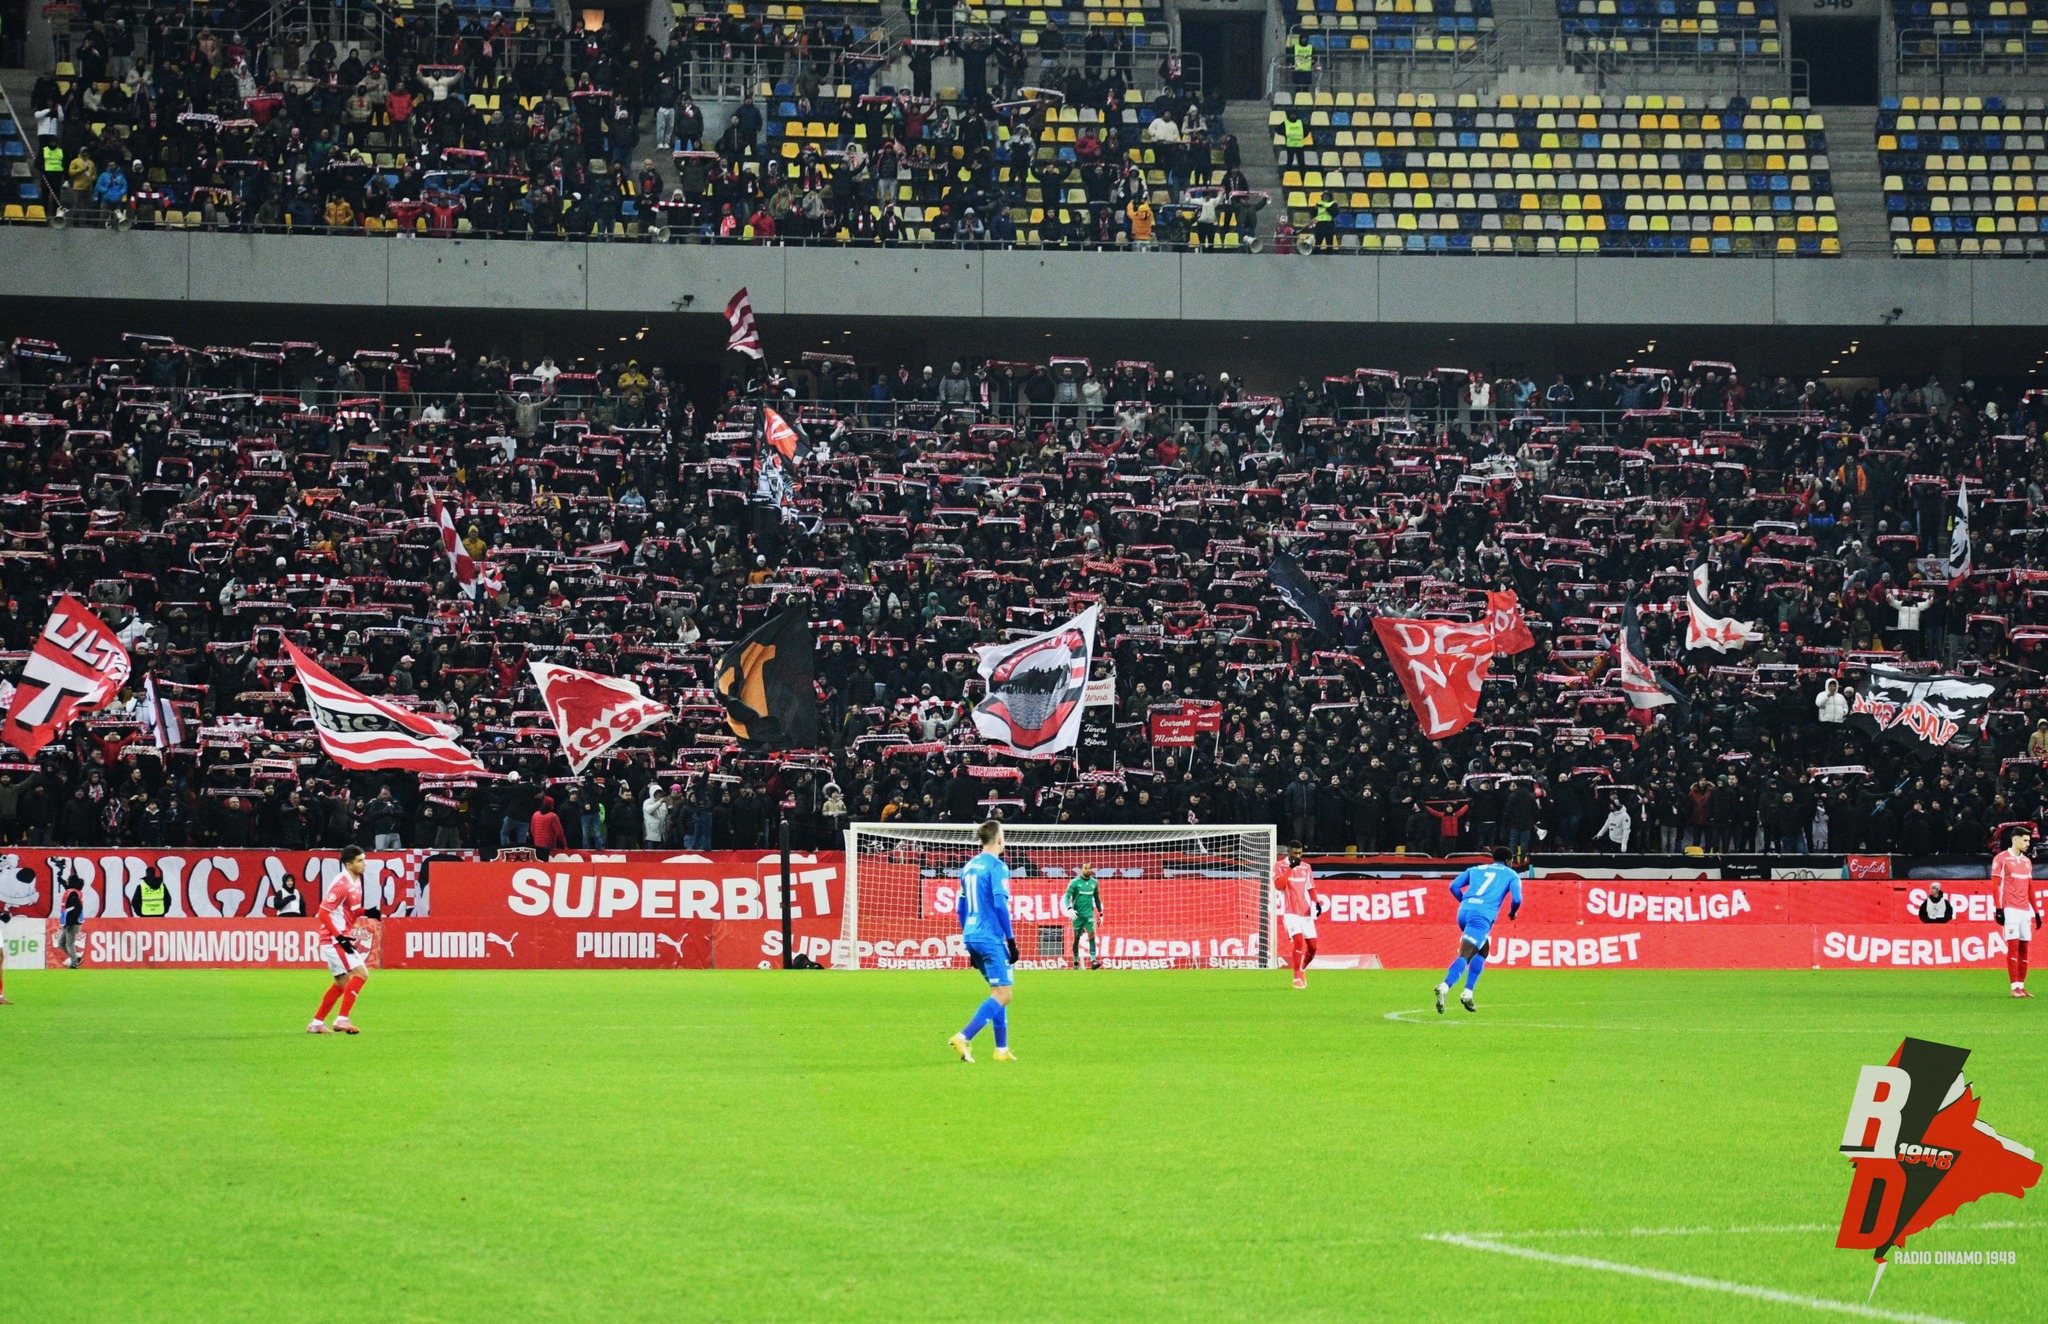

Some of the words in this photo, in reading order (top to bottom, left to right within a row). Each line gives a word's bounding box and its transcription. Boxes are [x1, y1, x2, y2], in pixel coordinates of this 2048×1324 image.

[1850, 859, 1887, 878] English
[508, 867, 838, 920] SUPERBET
[964, 874, 979, 914] 11
[1476, 872, 1497, 896] 7
[1306, 887, 1428, 922] PERBET
[1587, 888, 1751, 922] SUPERLIGA
[406, 932, 484, 958] PUMA
[576, 932, 654, 958] PUMA
[1458, 932, 1641, 967] UPERBET
[1822, 931, 2008, 965] SUPERLIGA
[877, 957, 952, 970] SUPERBET
[1102, 957, 1176, 970] SUPERBET
